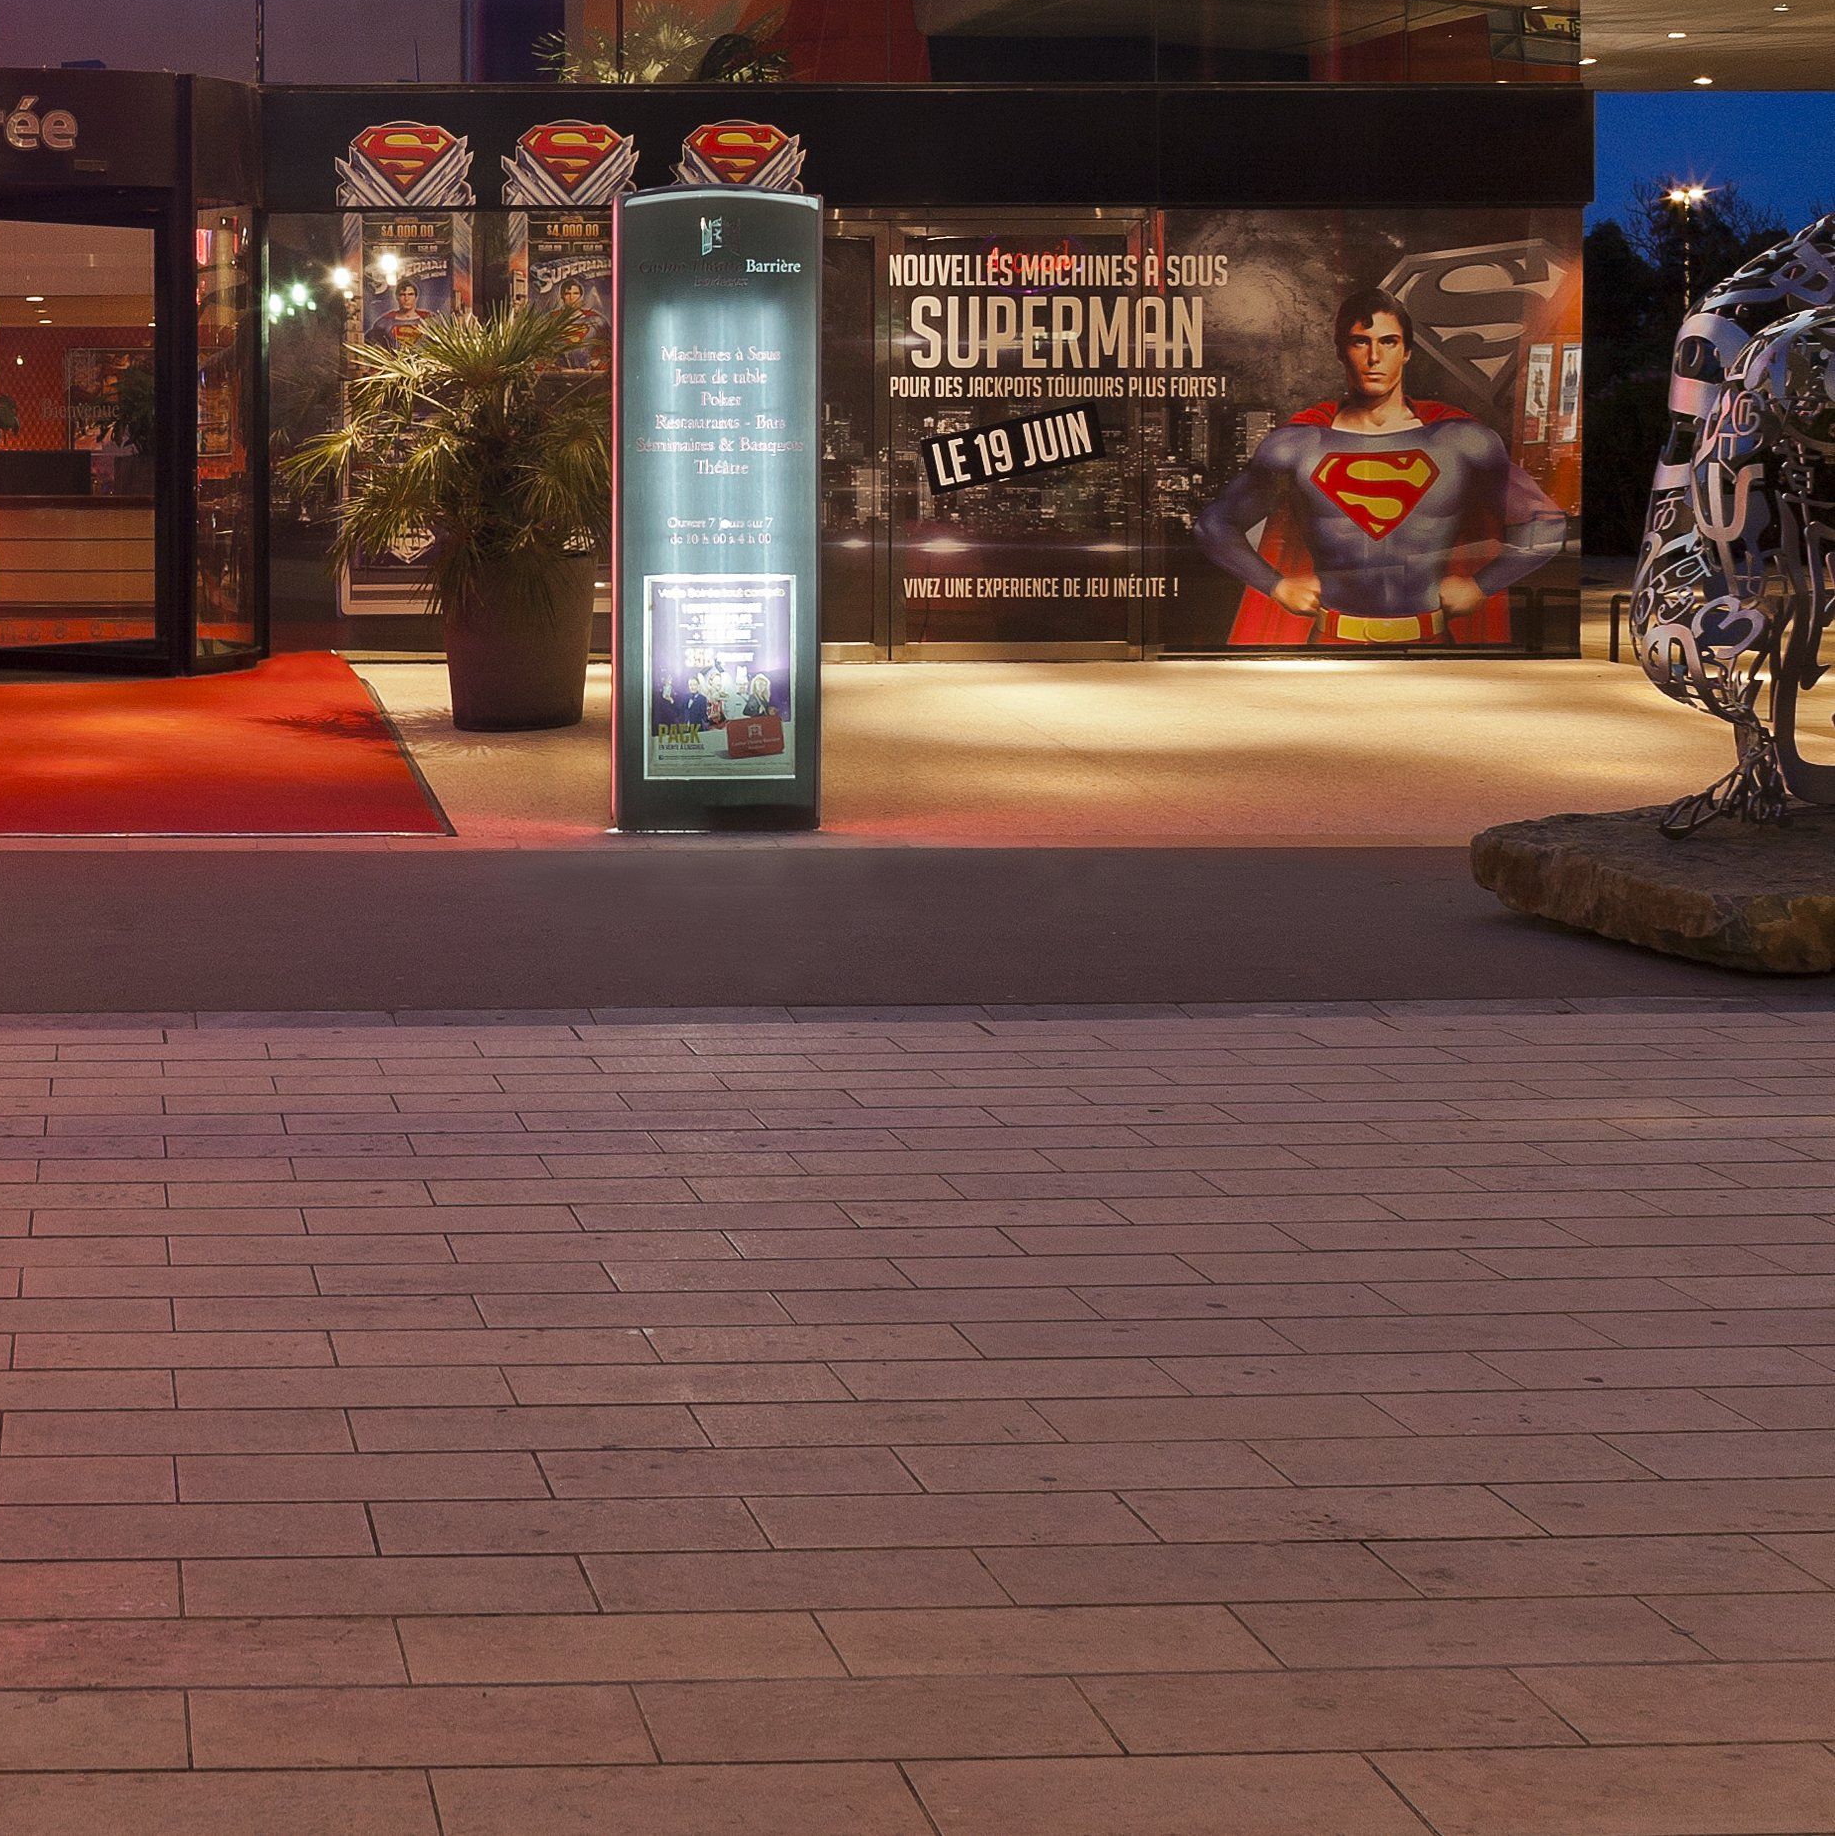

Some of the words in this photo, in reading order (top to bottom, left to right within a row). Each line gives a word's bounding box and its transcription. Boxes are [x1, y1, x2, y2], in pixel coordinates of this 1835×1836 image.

[531, 256, 612, 294] SUPERMAN
[746, 258, 802, 273] Barrière
[889, 254, 1013, 286] NOUVELLES
[1021, 254, 1137, 286] MACHINES
[1144, 248, 1160, 286] À
[1166, 254, 1228, 286] SOUS
[910, 295, 1204, 369] SUPERMAN
[661, 345, 732, 362] Machines
[747, 345, 781, 361] Sous
[673, 368, 706, 387] Jeux
[711, 368, 728, 385] de
[733, 368, 768, 385] table
[889, 376, 930, 398] POUR
[934, 376, 963, 398] DES
[966, 376, 1042, 398] JACKPOTS
[1046, 376, 1124, 398] TOUJOURS
[1128, 376, 1166, 398] PLUS
[1170, 376, 1217, 398] FORTS
[701, 391, 742, 407] Poker
[655, 414, 740, 430] Restaurants
[636, 437, 715, 453] Séminaires
[718, 437, 735, 452] &
[931, 437, 971, 486] LE
[974, 429, 1013, 476] 19
[1022, 410, 1093, 467] JUIN
[903, 578, 941, 599] VIVEZ
[944, 578, 972, 598] UNE
[976, 578, 1059, 598] EXPERIENCE
[1063, 578, 1081, 598] DE
[1084, 578, 1109, 598] JEU
[1113, 573, 1166, 598] INÉDITE
[658, 722, 701, 744] PACK
